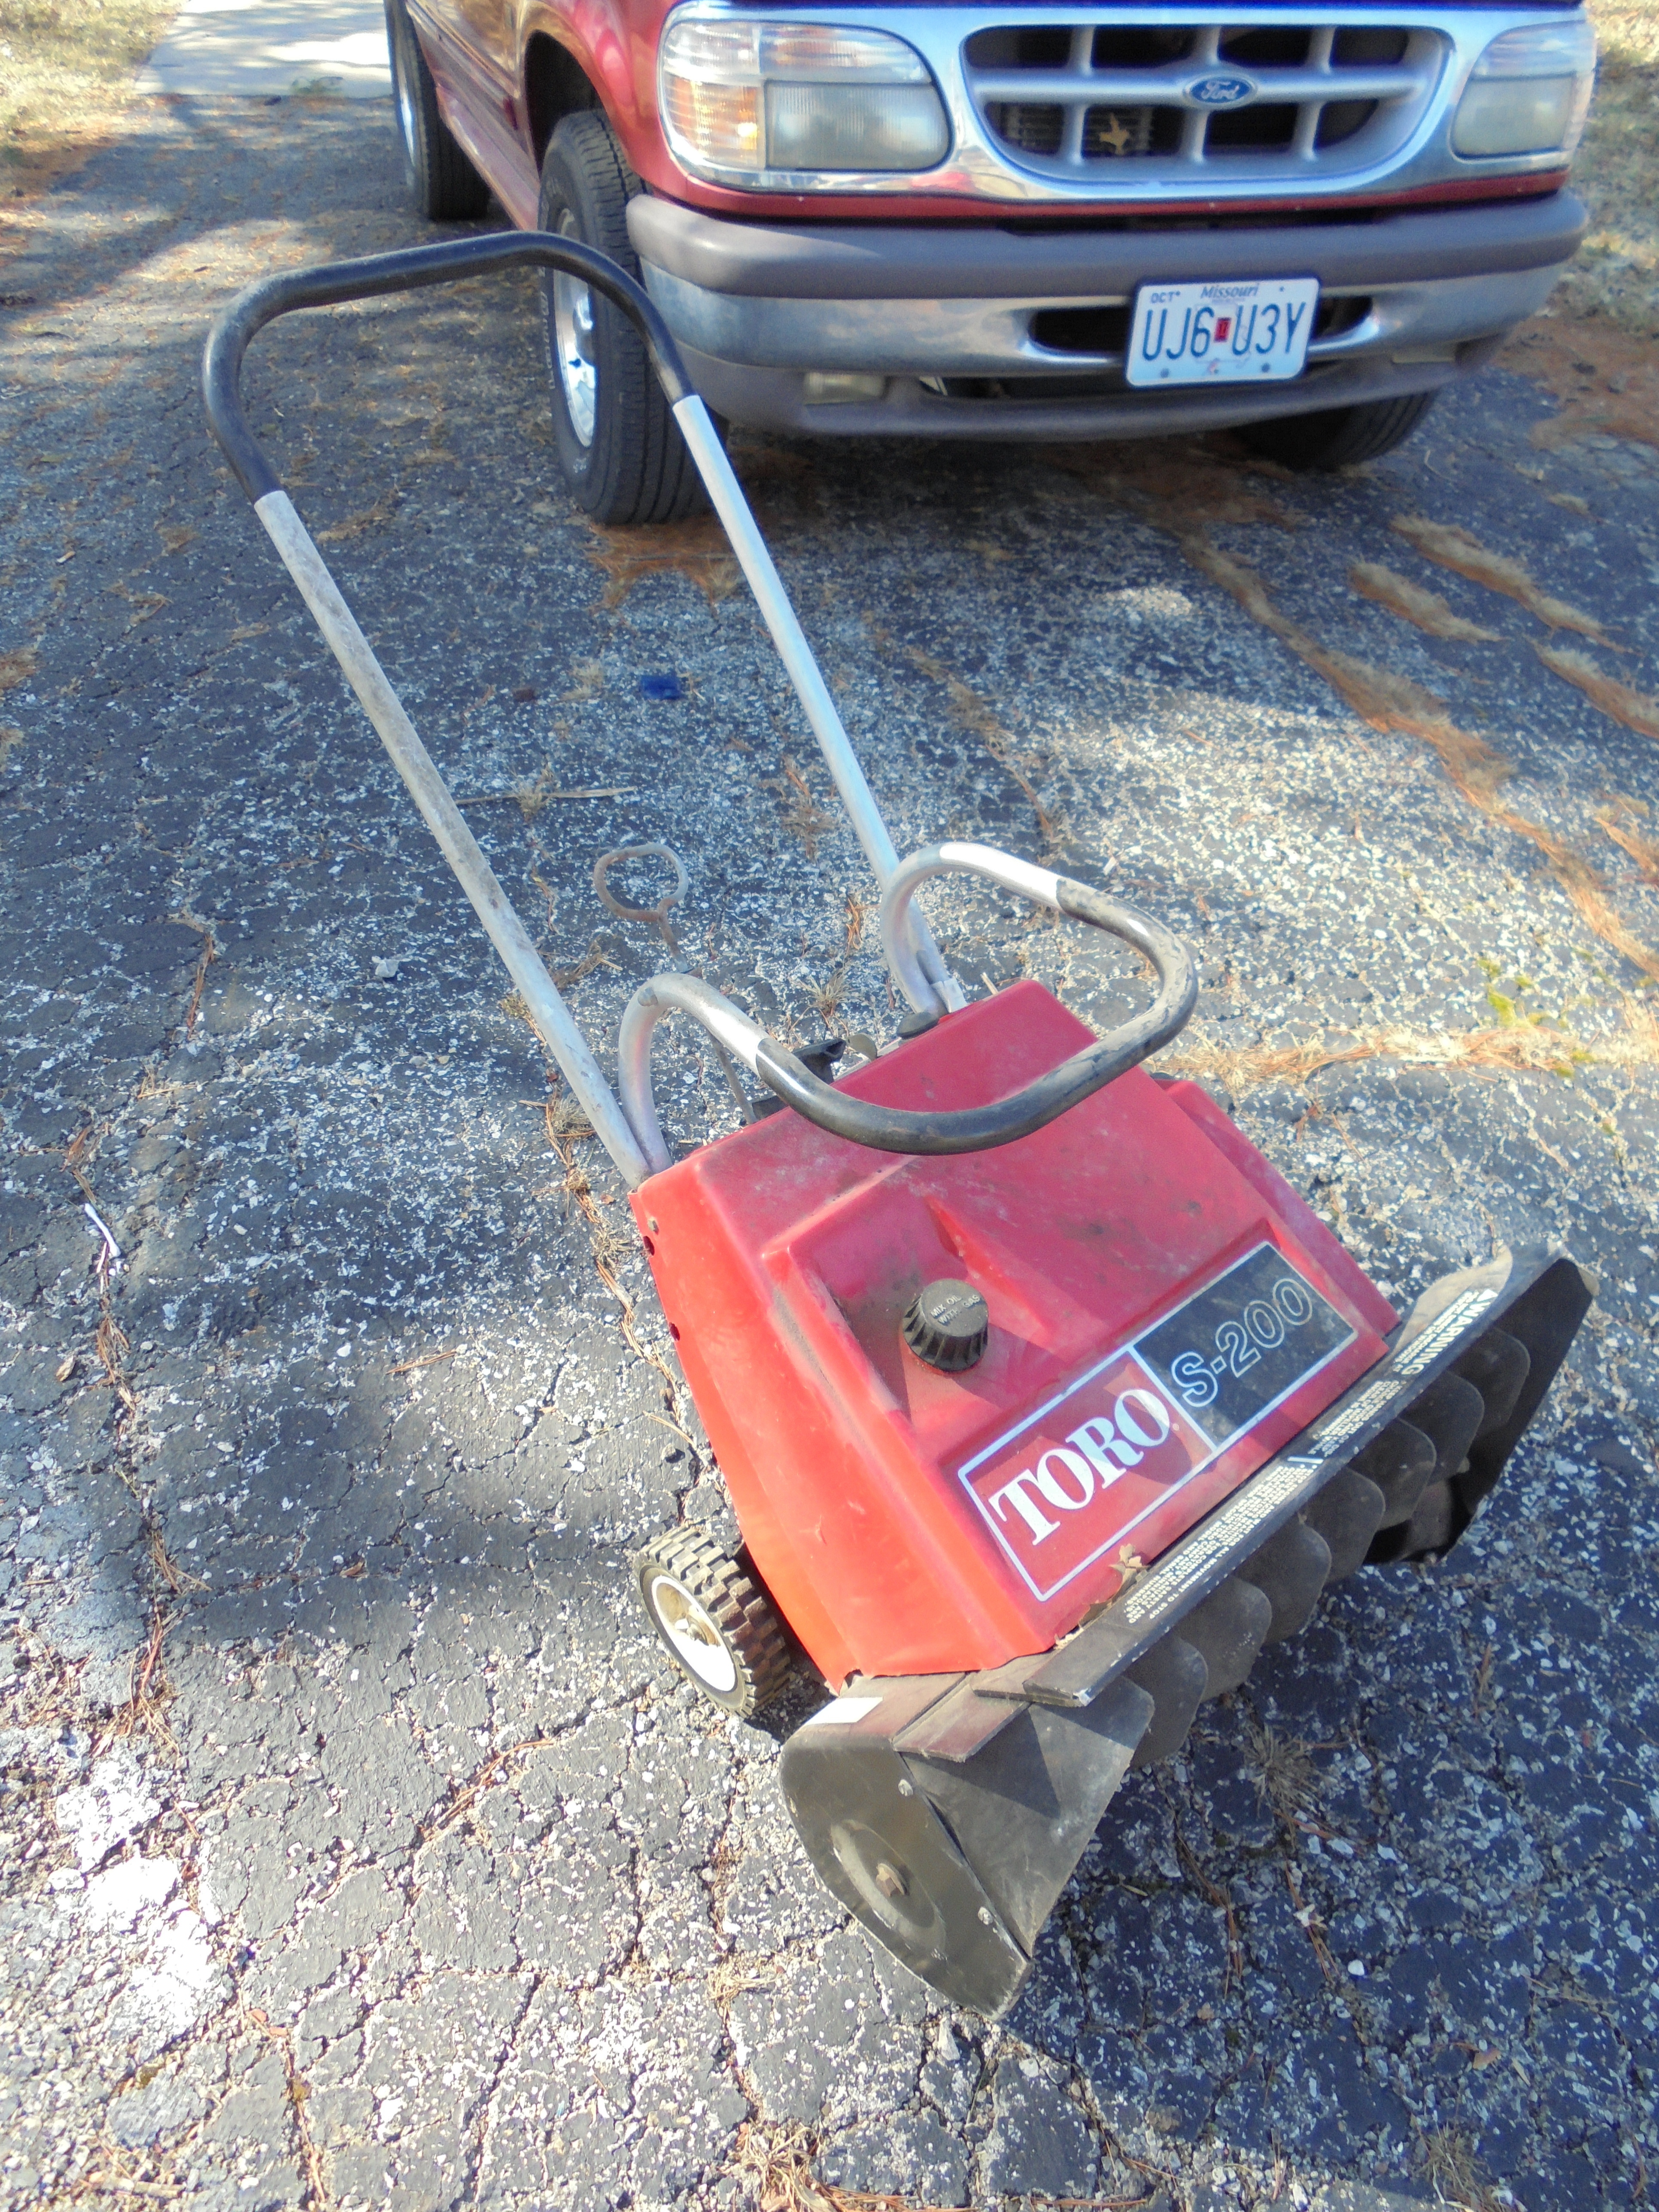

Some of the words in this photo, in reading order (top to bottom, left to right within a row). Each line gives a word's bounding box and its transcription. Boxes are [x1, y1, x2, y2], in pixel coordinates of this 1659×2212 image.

[1201, 81, 1240, 100] Ford
[1201, 283, 1259, 298] Missouri
[1142, 307, 1214, 360] UJ6
[1232, 303, 1306, 355] U3Y
[930, 1304, 947, 1318] MIX
[946, 1294, 963, 1306] OIL
[963, 1295, 980, 1308] GAS
[1171, 1278, 1313, 1407] S-200
[1400, 1302, 1491, 1374] WARNING
[1360, 1399, 1372, 1407] OF
[1361, 1400, 1387, 1421] HANDS
[1329, 1408, 1363, 1435] IMPELLER
[1351, 1404, 1374, 1422] GUIDE
[1337, 1423, 1355, 1436] AND
[1346, 1421, 1364, 1434] OUT
[1307, 1436, 1333, 1455] WHILE
[1337, 1434, 1350, 1443] OF
[988, 1389, 1170, 1545] TORO
[1258, 1505, 1276, 1518] AND
[1196, 1520, 1224, 1541] MODEL
[1206, 1524, 1228, 1540] TORO
[1218, 1517, 1250, 1541] MANUAL
[1182, 1541, 1200, 1555] AND
[1204, 1542, 1221, 1554] FOR
[1228, 1534, 1245, 1547] FOR
[1215, 1546, 1231, 1558] ALL
[1158, 1554, 1185, 1574] SERIAL
[1170, 1555, 1208, 1586] COMPLETE
[1178, 1557, 1218, 1592] MOVEMENT
[1140, 1576, 1177, 1605] MANUALS
[1145, 1586, 1173, 1609] SAFETY
[1166, 1593, 1180, 1602] TO
[1124, 1606, 1143, 1618] ARE
[1127, 1609, 1147, 1624] AND
[1149, 1602, 1169, 1619] STOP
